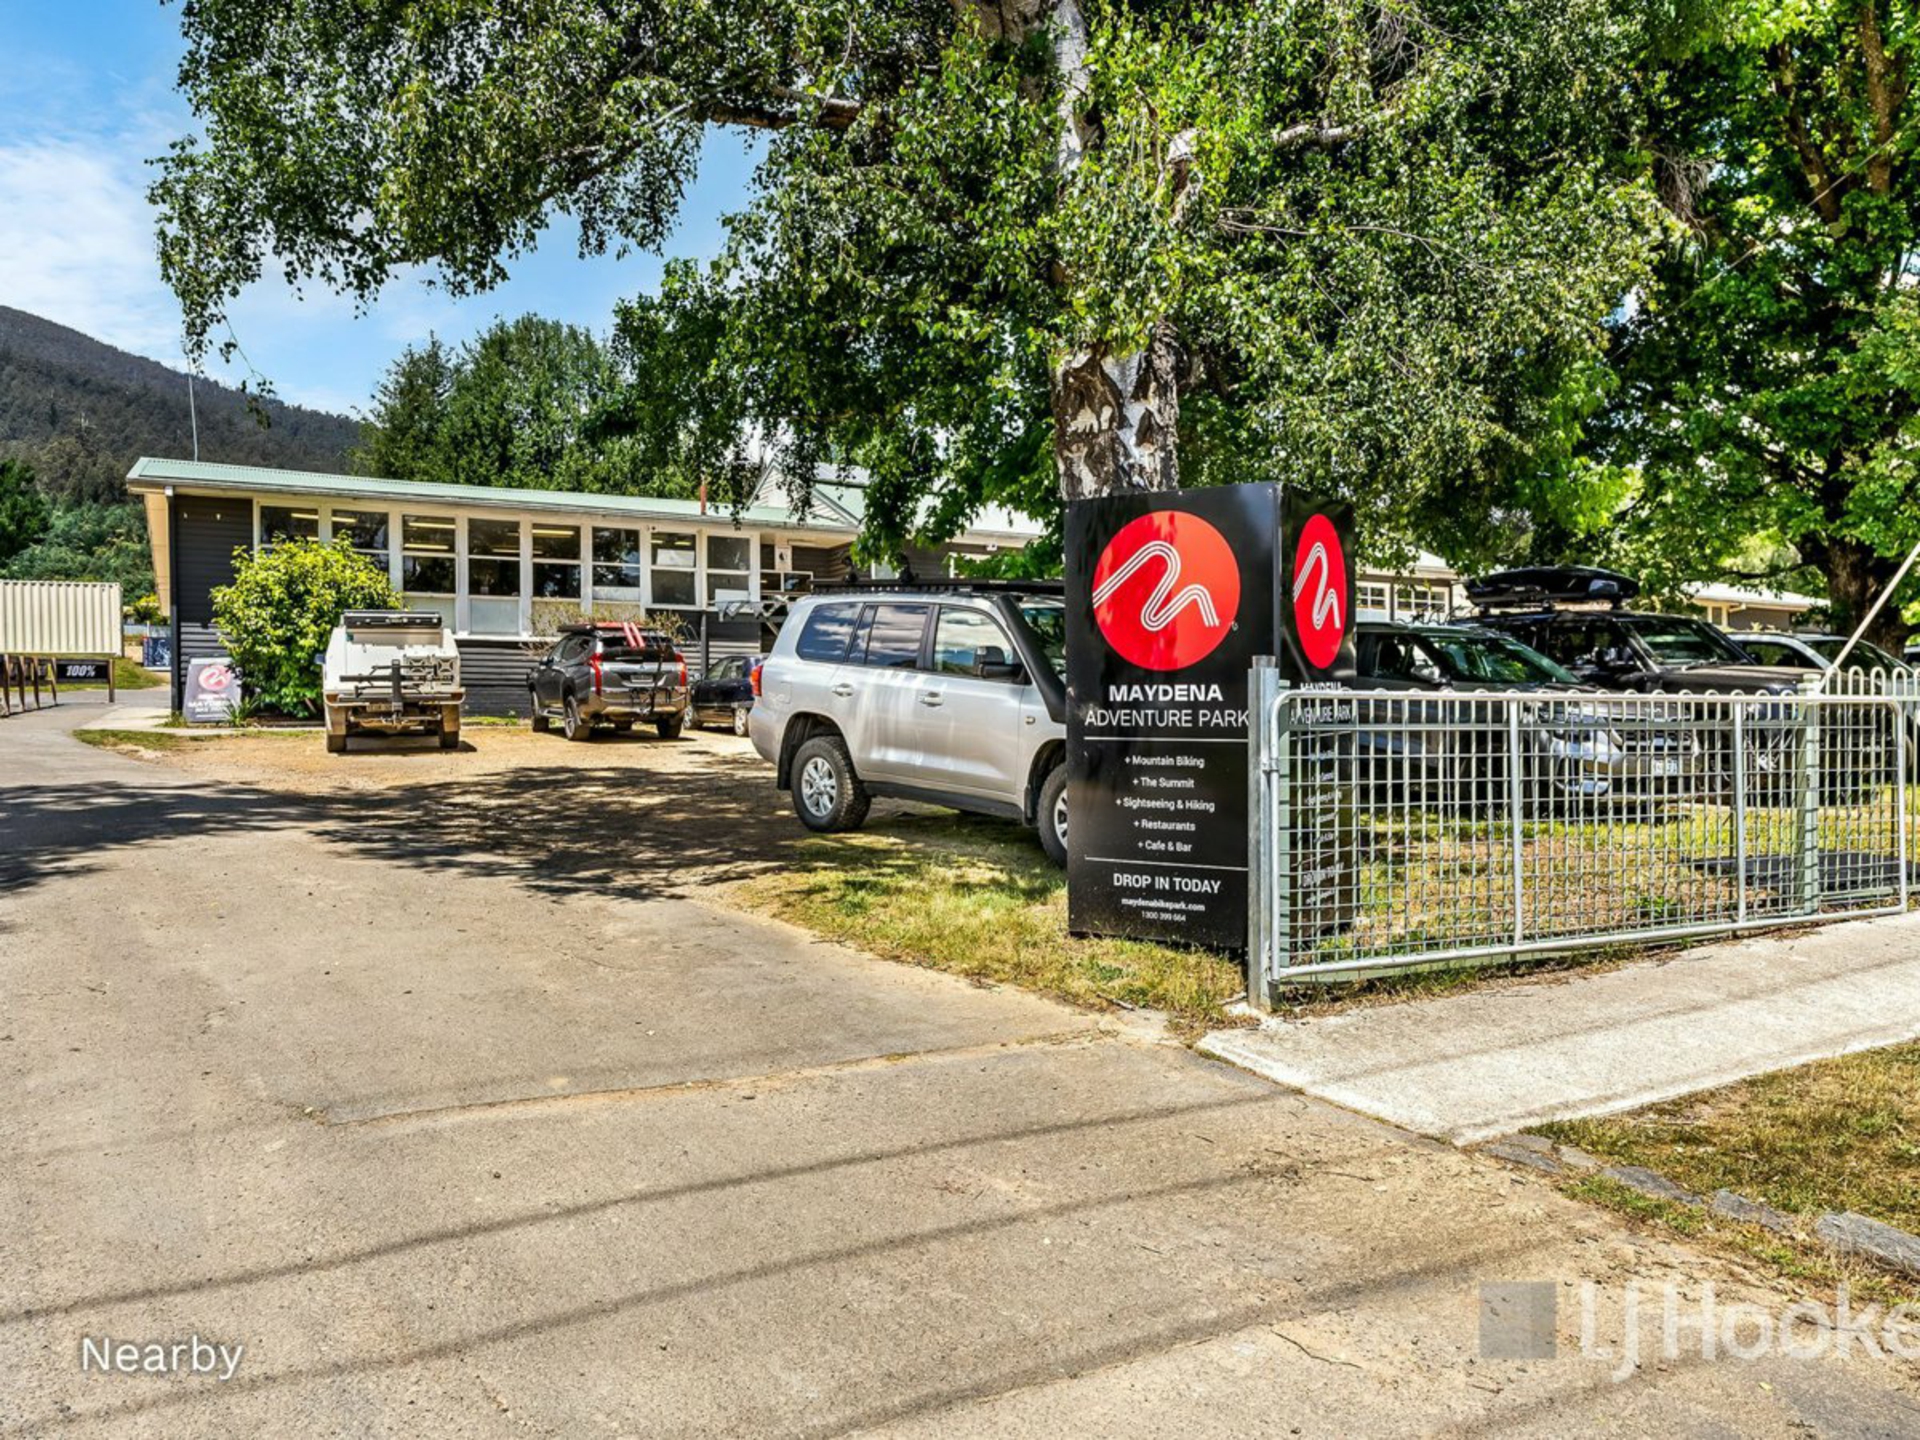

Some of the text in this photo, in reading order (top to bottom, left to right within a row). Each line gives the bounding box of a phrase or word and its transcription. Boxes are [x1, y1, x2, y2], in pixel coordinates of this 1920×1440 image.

[66, 665, 96, 677] 100%
[1109, 684, 1223, 702] MAYDENA
[1085, 709, 1249, 727] ADVENTURE PARK
[1132, 755, 1174, 766] Mountain
[1176, 756, 1205, 769] Biking
[1140, 776, 1157, 788] The
[1159, 777, 1195, 789] Summit
[1123, 797, 1175, 811] Sightseeing
[1176, 800, 1184, 810] &
[1185, 800, 1216, 813] Hiking
[1141, 819, 1196, 832] Restaurants
[1145, 840, 1166, 851] Cafe
[1168, 841, 1175, 851] &
[1176, 842, 1192, 852] Bar
[1113, 873, 1221, 894] DROP IN TODAY
[1121, 897, 1206, 912] maydenabikepark.com
